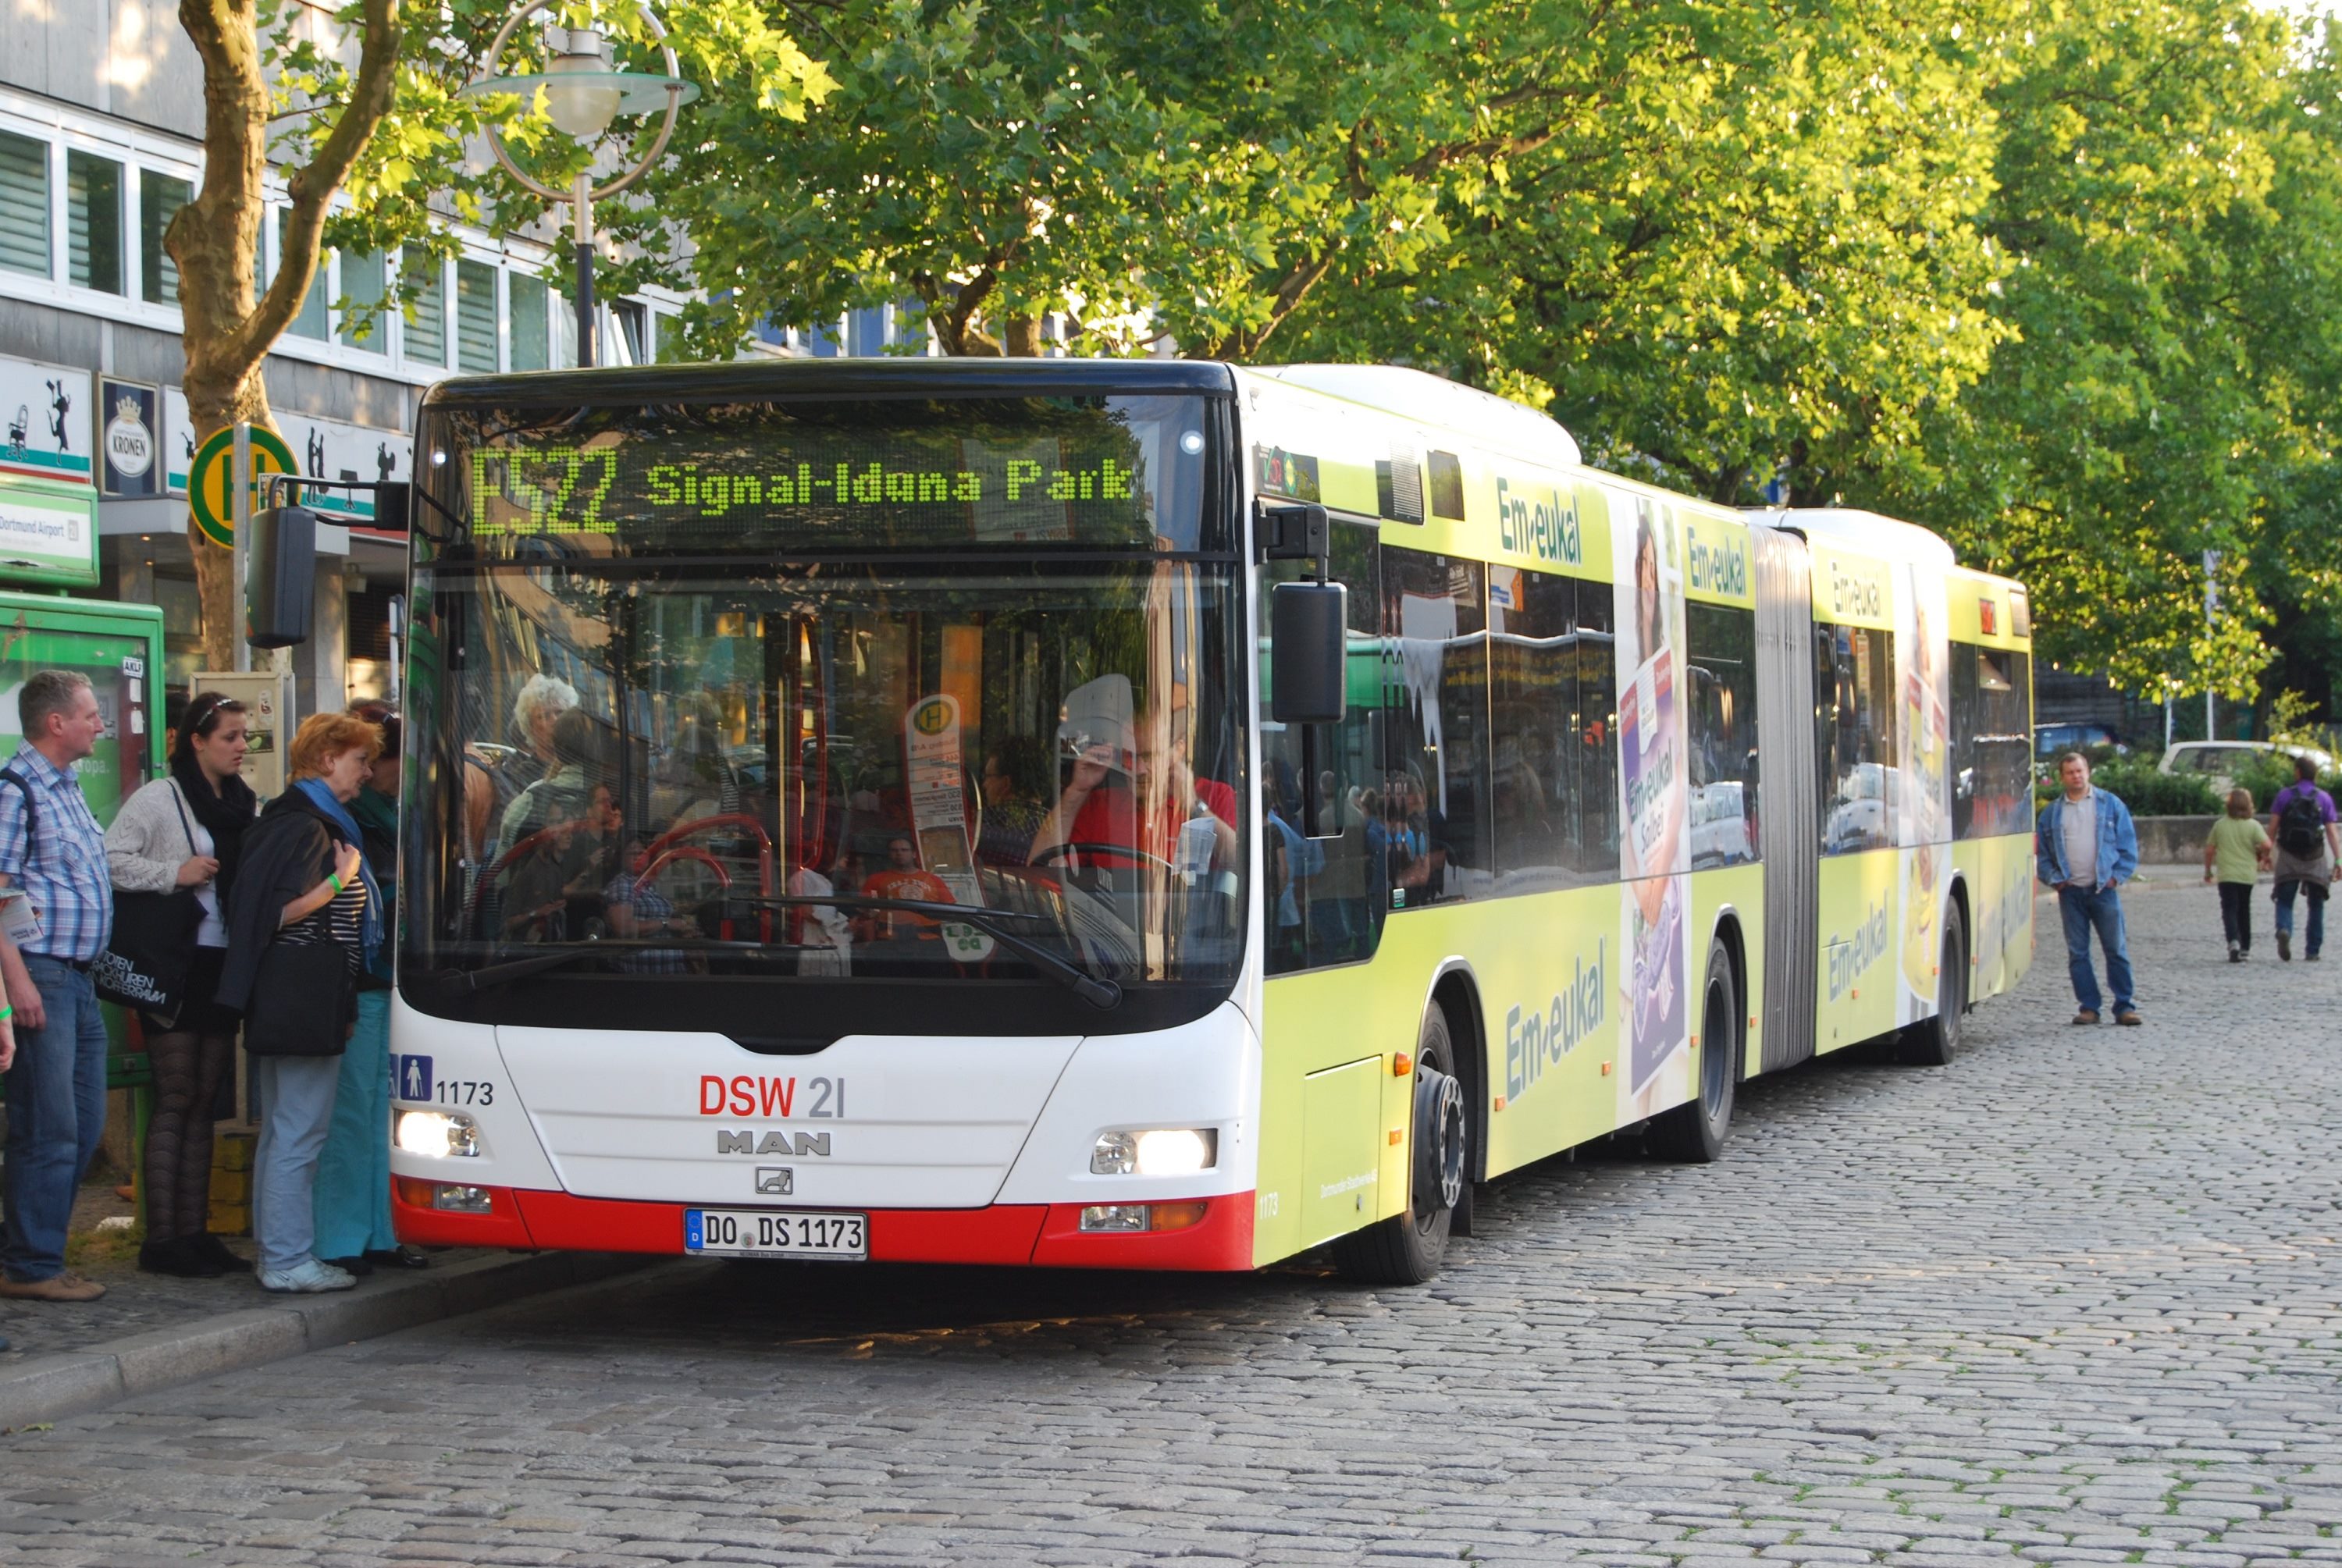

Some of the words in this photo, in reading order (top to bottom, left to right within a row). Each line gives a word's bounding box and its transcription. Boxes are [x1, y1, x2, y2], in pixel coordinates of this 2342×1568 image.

[113, 435, 147, 457] KRONEN
[1006, 458, 1132, 500] Park
[0, 516, 37, 534] Dortmund
[37, 521, 65, 539] Airport
[1497, 476, 1581, 564] Em-eukal
[1687, 525, 1746, 596] Em-eukal
[103, 950, 134, 972] TOTEN
[1830, 887, 1887, 1002] Em-eukal
[1506, 937, 1604, 1103] Em-eukal
[436, 1080, 493, 1106] 1173
[699, 1075, 796, 1118] DSW
[717, 1129, 831, 1157] MAN
[1259, 1191, 1279, 1219] 1173
[706, 1215, 737, 1245] DO
[758, 1217, 790, 1247] DS
[798, 1218, 862, 1249] 1173
